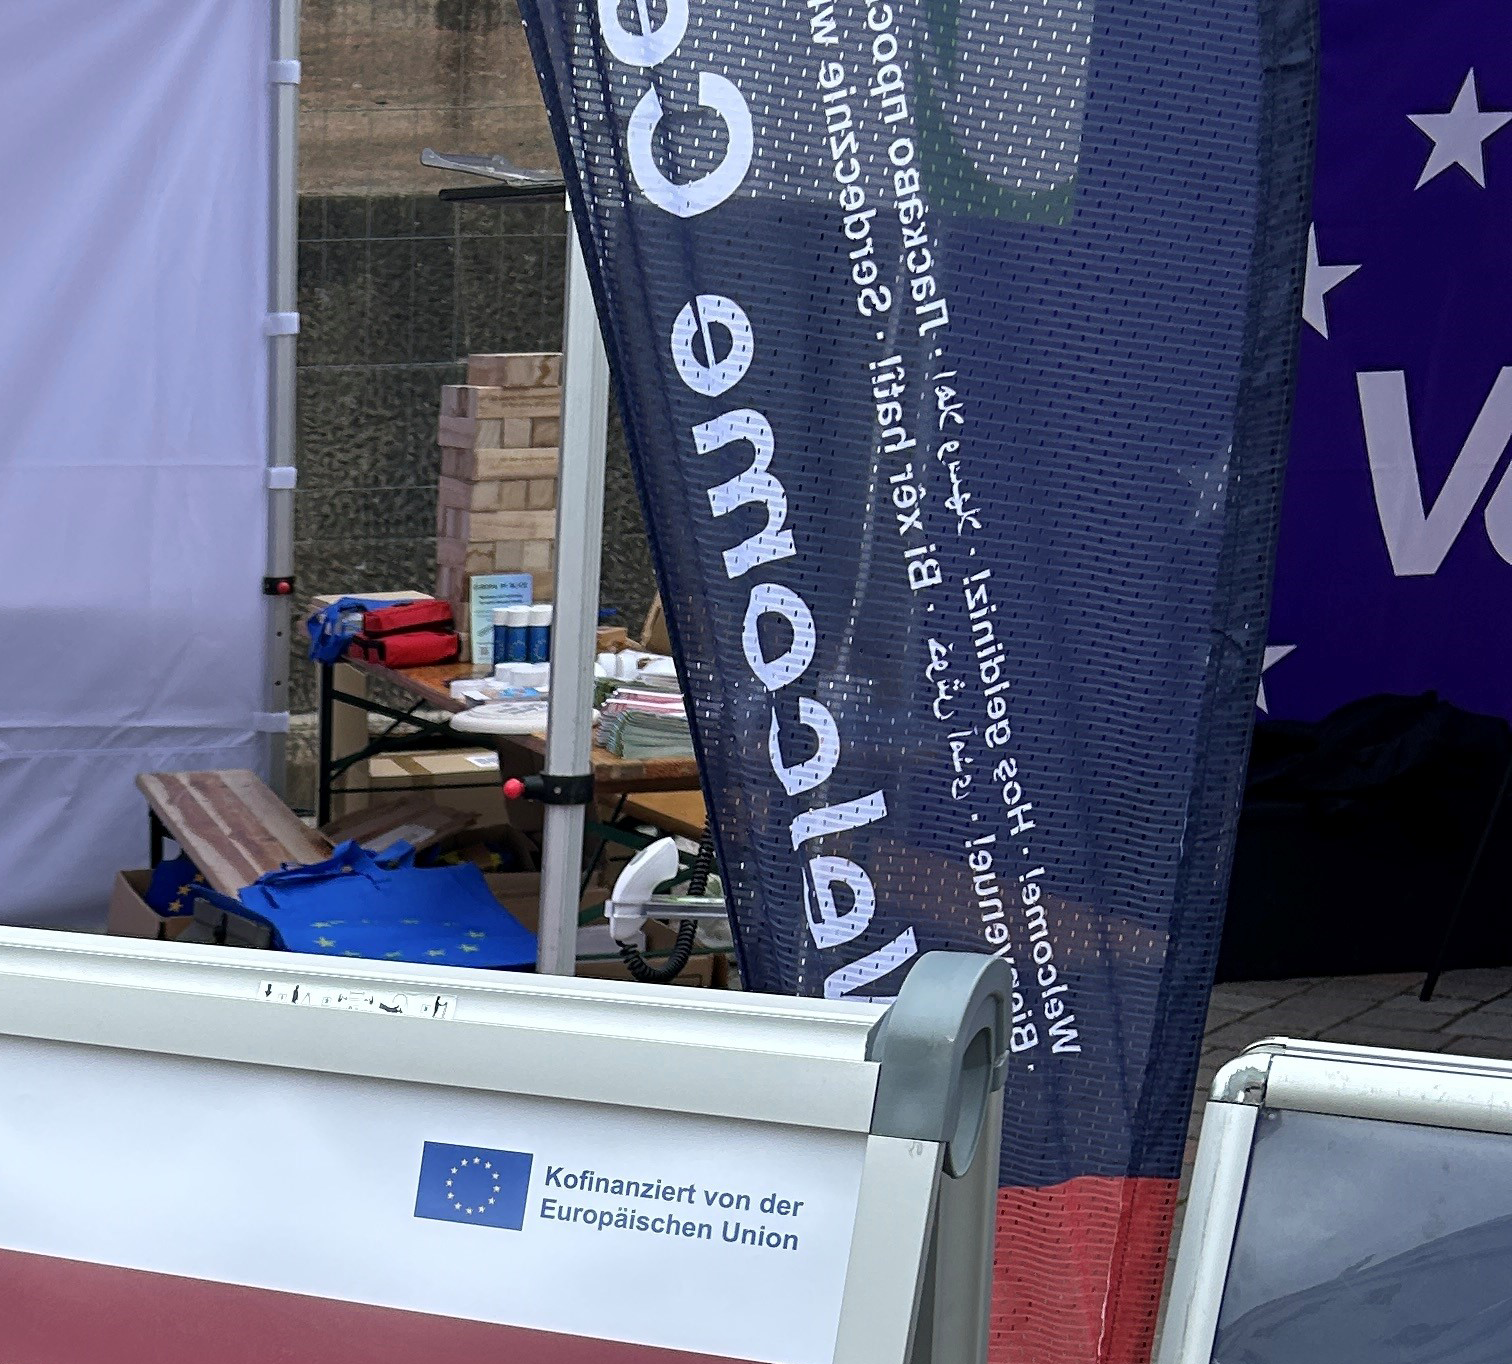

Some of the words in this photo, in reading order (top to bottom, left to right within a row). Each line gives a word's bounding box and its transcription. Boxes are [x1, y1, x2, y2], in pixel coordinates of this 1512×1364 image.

[545, 1166, 696, 1204] Kofinanziert
[704, 1190, 750, 1210] von
[760, 1193, 804, 1216] der
[540, 1198, 712, 1239] Europäischen
[723, 1221, 798, 1250] Union
